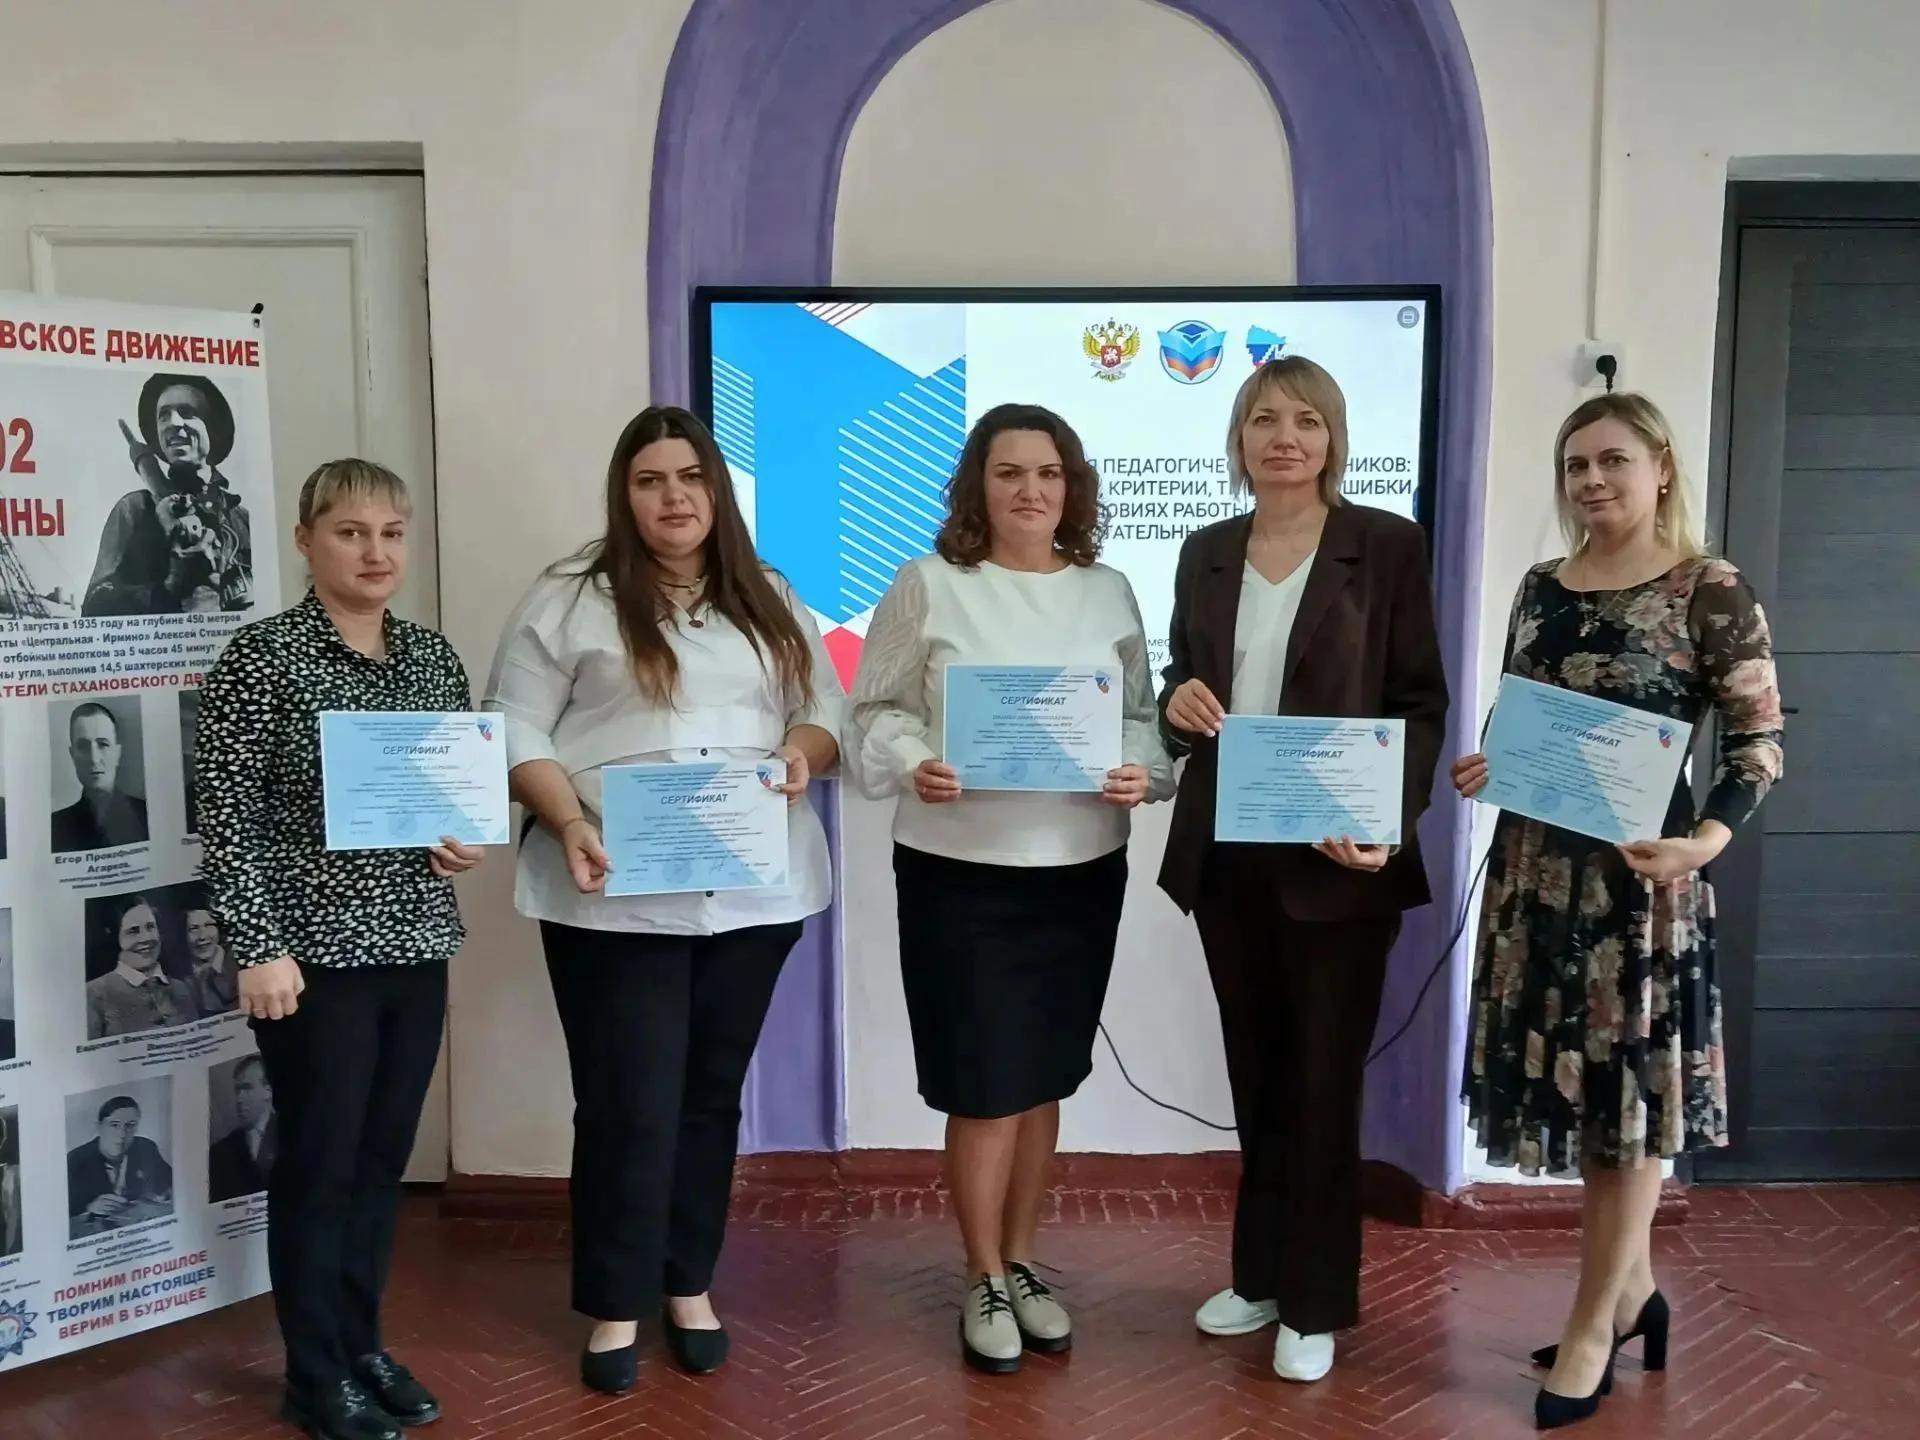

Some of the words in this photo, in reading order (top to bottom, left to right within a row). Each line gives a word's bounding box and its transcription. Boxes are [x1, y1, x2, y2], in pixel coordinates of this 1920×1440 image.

[0, 319, 96, 355] ВСКОЕ
[105, 329, 260, 367] ДВИЖЕНИЕ
[0, 417, 36, 474] 2
[1103, 458, 1226, 476] ПЕДАГОГИЧЕ
[1109, 480, 1212, 498] КРИТЕРИИ,
[1343, 479, 1412, 495] ШИБКИ
[1173, 502, 1248, 518] РАБОТЫ
[1104, 524, 1206, 540] ТАТЕЛЬН
[7, 622, 20, 632] 31
[23, 621, 60, 633] августа
[73, 618, 98, 629] 1935
[100, 618, 124, 630] году
[126, 619, 140, 627] на
[142, 615, 184, 628] глубине
[187, 614, 204, 624] 450
[207, 613, 241, 625] метров
[153, 629, 197, 641] Алексей
[3, 650, 56, 664] отбойным
[58, 649, 111, 661] молотком
[113, 647, 127, 657] за
[129, 646, 136, 656] 5
[138, 646, 169, 656] часов
[170, 643, 183, 654] 45
[186, 643, 217, 655] минут
[47, 665, 97, 677] выполнив
[100, 661, 122, 674] 14,5
[124, 660, 187, 672] шахтерских
[0, 683, 48, 698] ТЕЛИ
[52, 674, 179, 695] СТАХАНОВСКОГО
[1000, 695, 1067, 706] СЕРТИФИКАТ
[1551, 721, 1621, 749] СЕРТИФИКАТ
[382, 745, 451, 756] СЕРТИФИКАТ
[1275, 748, 1345, 760] СЕРТИФИКАТ
[660, 793, 729, 805] СЕРТИФИКАТ
[54, 1272, 127, 1304] ПОМНИМ
[131, 1249, 209, 1282] ПРОШЛОЕ
[46, 1293, 115, 1324] ТВОРИМ
[119, 1265, 216, 1303] НАСТОЯЩЕЕ
[58, 1313, 115, 1340] ВЕРИМ
[119, 1308, 130, 1323] В
[134, 1286, 208, 1318] БУДУЩЕЕ
